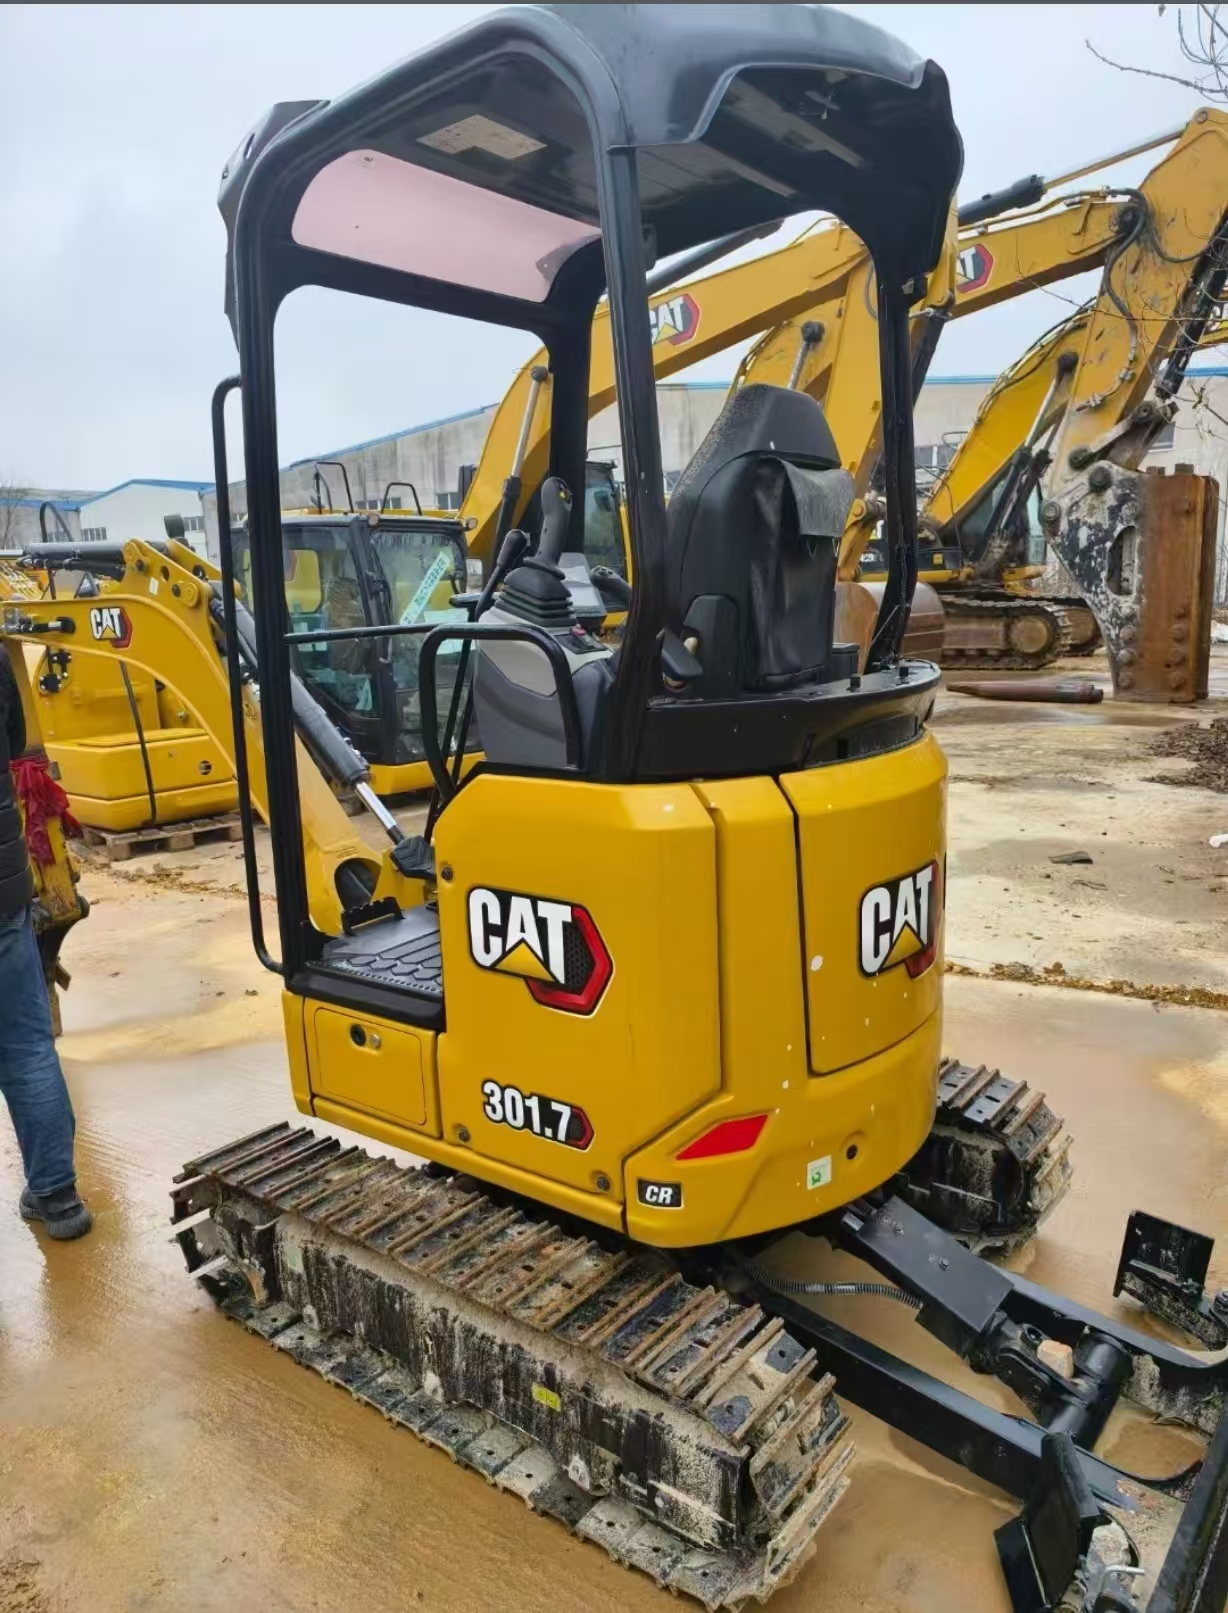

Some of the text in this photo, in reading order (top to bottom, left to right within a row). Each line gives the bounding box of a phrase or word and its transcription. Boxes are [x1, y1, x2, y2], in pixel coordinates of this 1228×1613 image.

[91, 608, 121, 639] CAT
[469, 887, 572, 985] CAT
[861, 863, 933, 974] CAT
[483, 1081, 571, 1142] 301.7
[645, 1185, 673, 1205] CR
